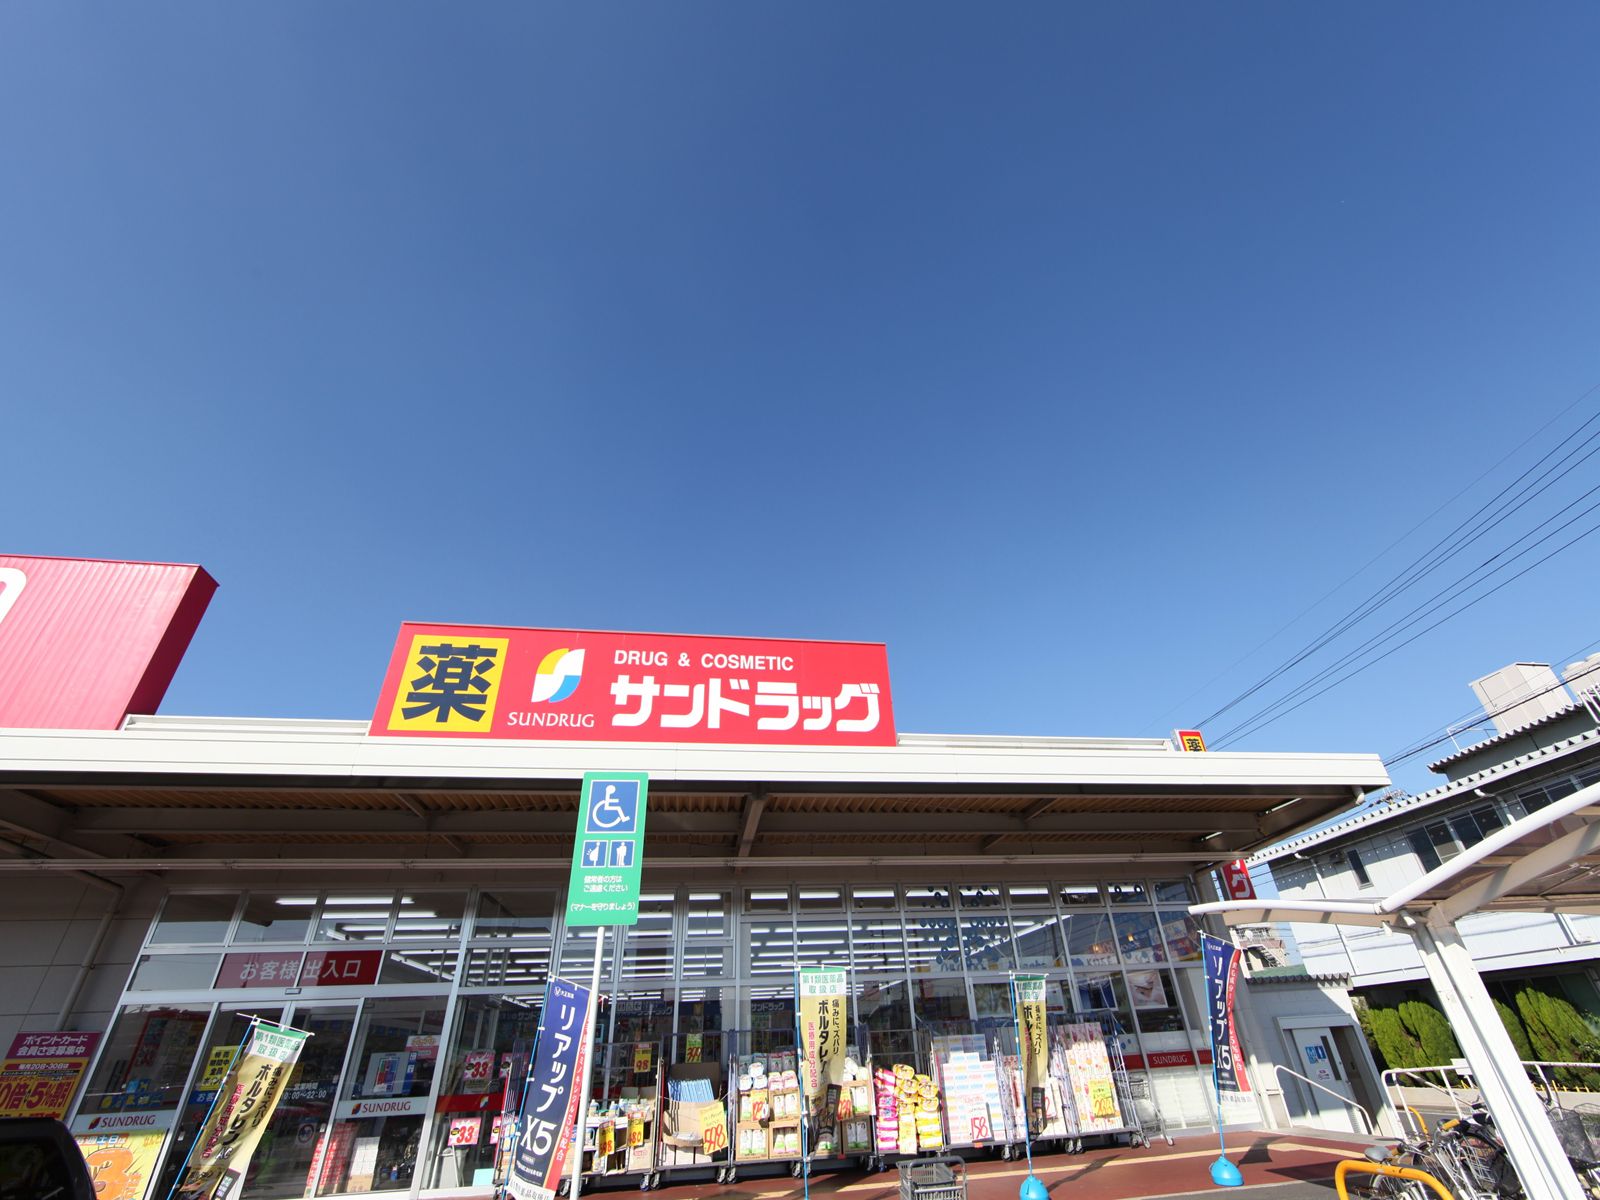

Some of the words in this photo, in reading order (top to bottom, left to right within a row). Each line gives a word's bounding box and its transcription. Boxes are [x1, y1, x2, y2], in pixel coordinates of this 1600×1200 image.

[614, 649, 668, 667] DRUG
[678, 652, 690, 667] &
[701, 653, 794, 671] COSMETIC
[402, 644, 498, 723] 薬
[610, 674, 880, 733] サンドラッグ
[507, 711, 595, 728] SUNDRUG
[240, 959, 362, 980] お客様出入口
[808, 985, 837, 994] 取扱店
[23, 1035, 89, 1045] ポイントカード
[16, 1045, 86, 1057] 会員さま募集中
[636, 1060, 649, 1071] 98
[1152, 1054, 1188, 1065] SUNDRUG
[471, 1061, 489, 1079] 33
[362, 1100, 412, 1113] SUNDRUG
[100, 1114, 156, 1128] SUNDRUG
[456, 1125, 475, 1144] 33
